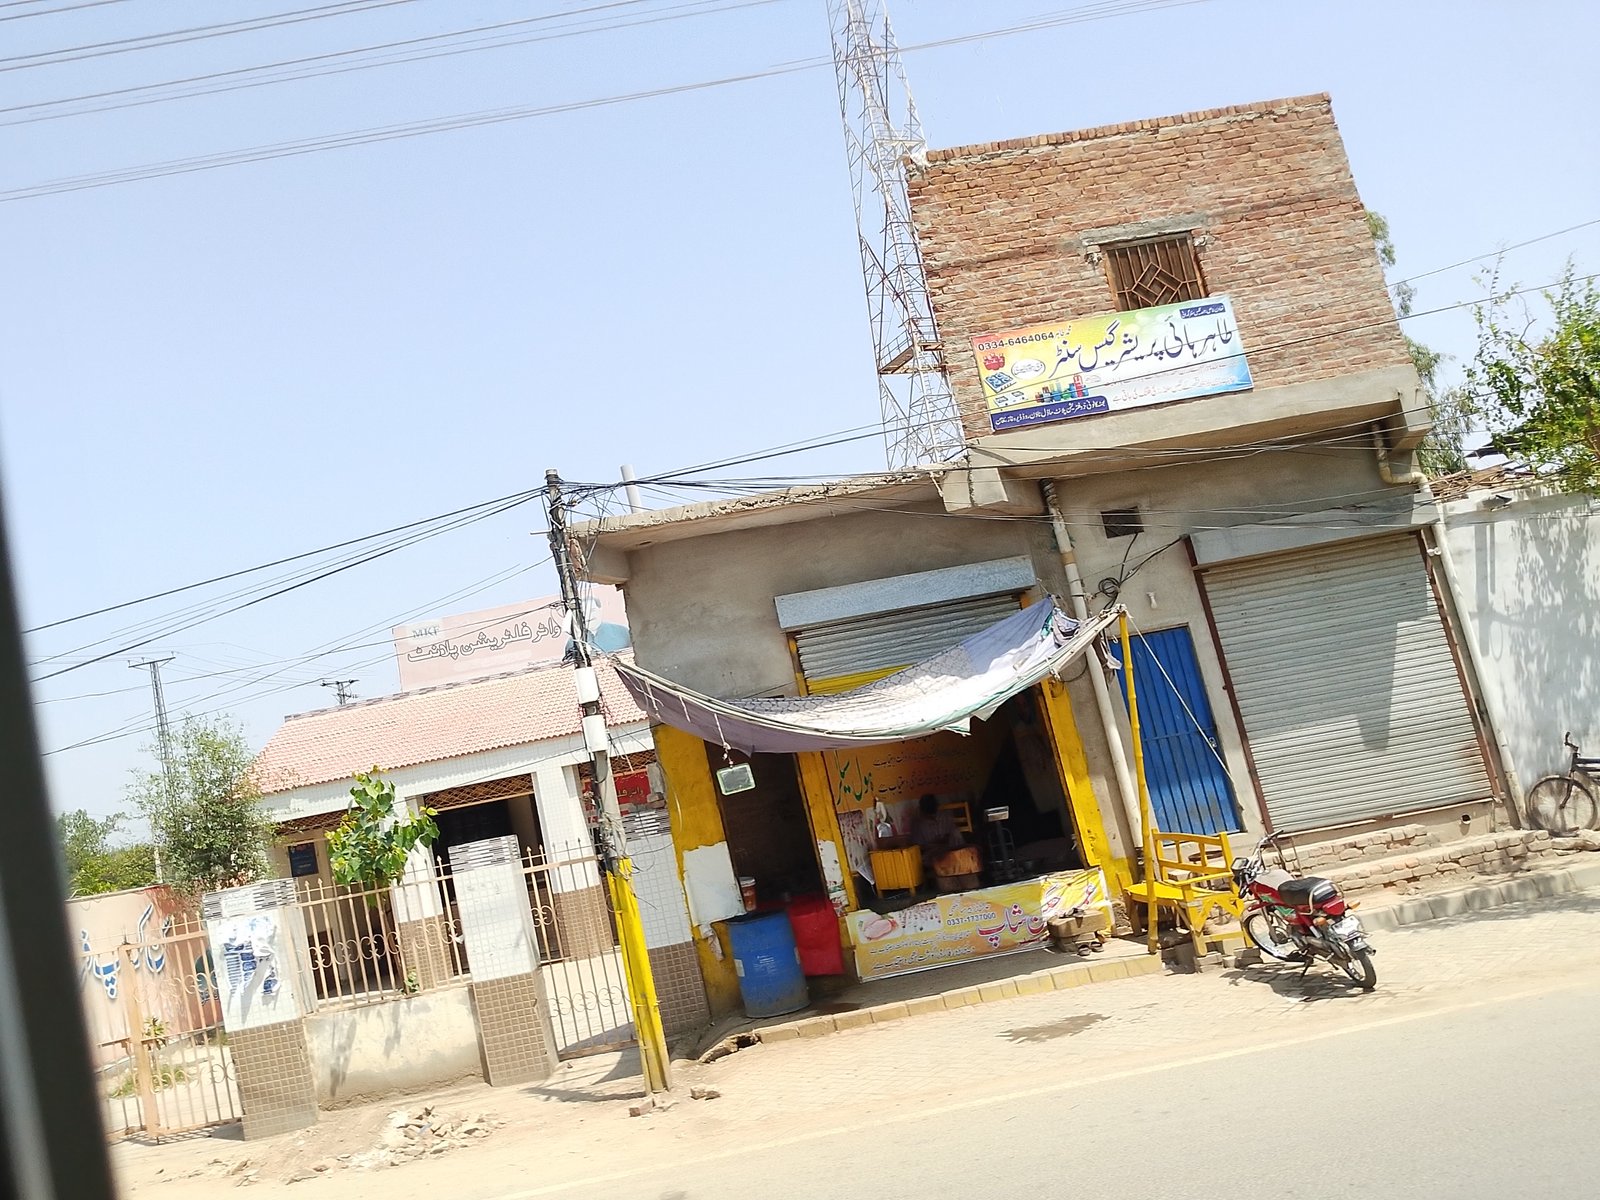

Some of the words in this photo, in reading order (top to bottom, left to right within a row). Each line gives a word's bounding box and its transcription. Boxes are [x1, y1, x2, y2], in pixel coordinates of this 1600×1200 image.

[978, 331, 1055, 351] 0334-6464064
[1079, 318, 1120, 371] گیس
[1114, 332, 1164, 370] پریشر
[1199, 318, 1233, 357] طاہر
[1048, 341, 1082, 378] سنٹر
[460, 621, 533, 655] فلٹریشن
[533, 617, 562, 643] واٹر
[407, 639, 459, 662] پلانٹ
[976, 903, 1028, 948] شاپ
